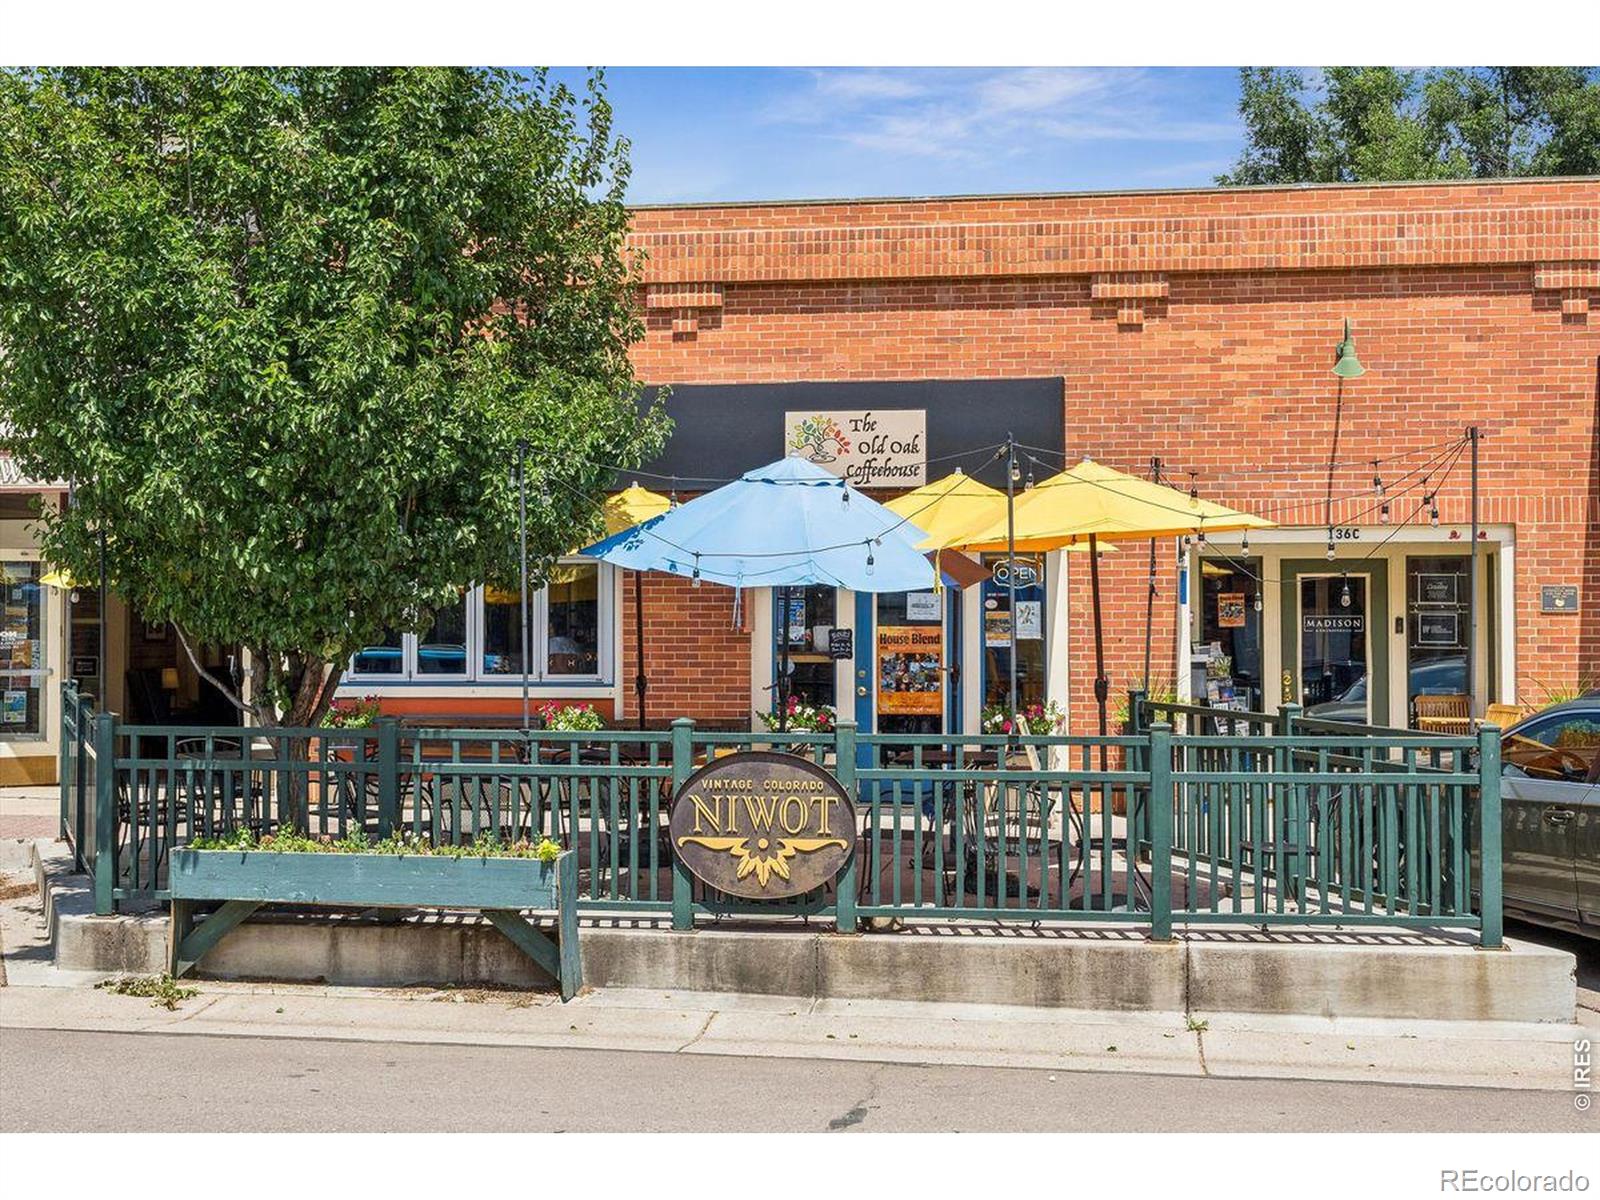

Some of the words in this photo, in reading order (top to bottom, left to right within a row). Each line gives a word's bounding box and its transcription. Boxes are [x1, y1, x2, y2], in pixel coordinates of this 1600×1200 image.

[849, 412, 877, 432] The
[858, 434, 888, 455] Old
[890, 434, 921, 454] Oak
[846, 457, 921, 485] Coffeehouse
[997, 567, 1037, 580] OPEN
[1306, 619, 1361, 628] MADISON
[879, 633, 909, 645] House
[911, 633, 941, 645] Blend
[702, 779, 753, 791] VINTAGE
[763, 780, 824, 792] COLORADO
[688, 794, 841, 837] NIWOT
